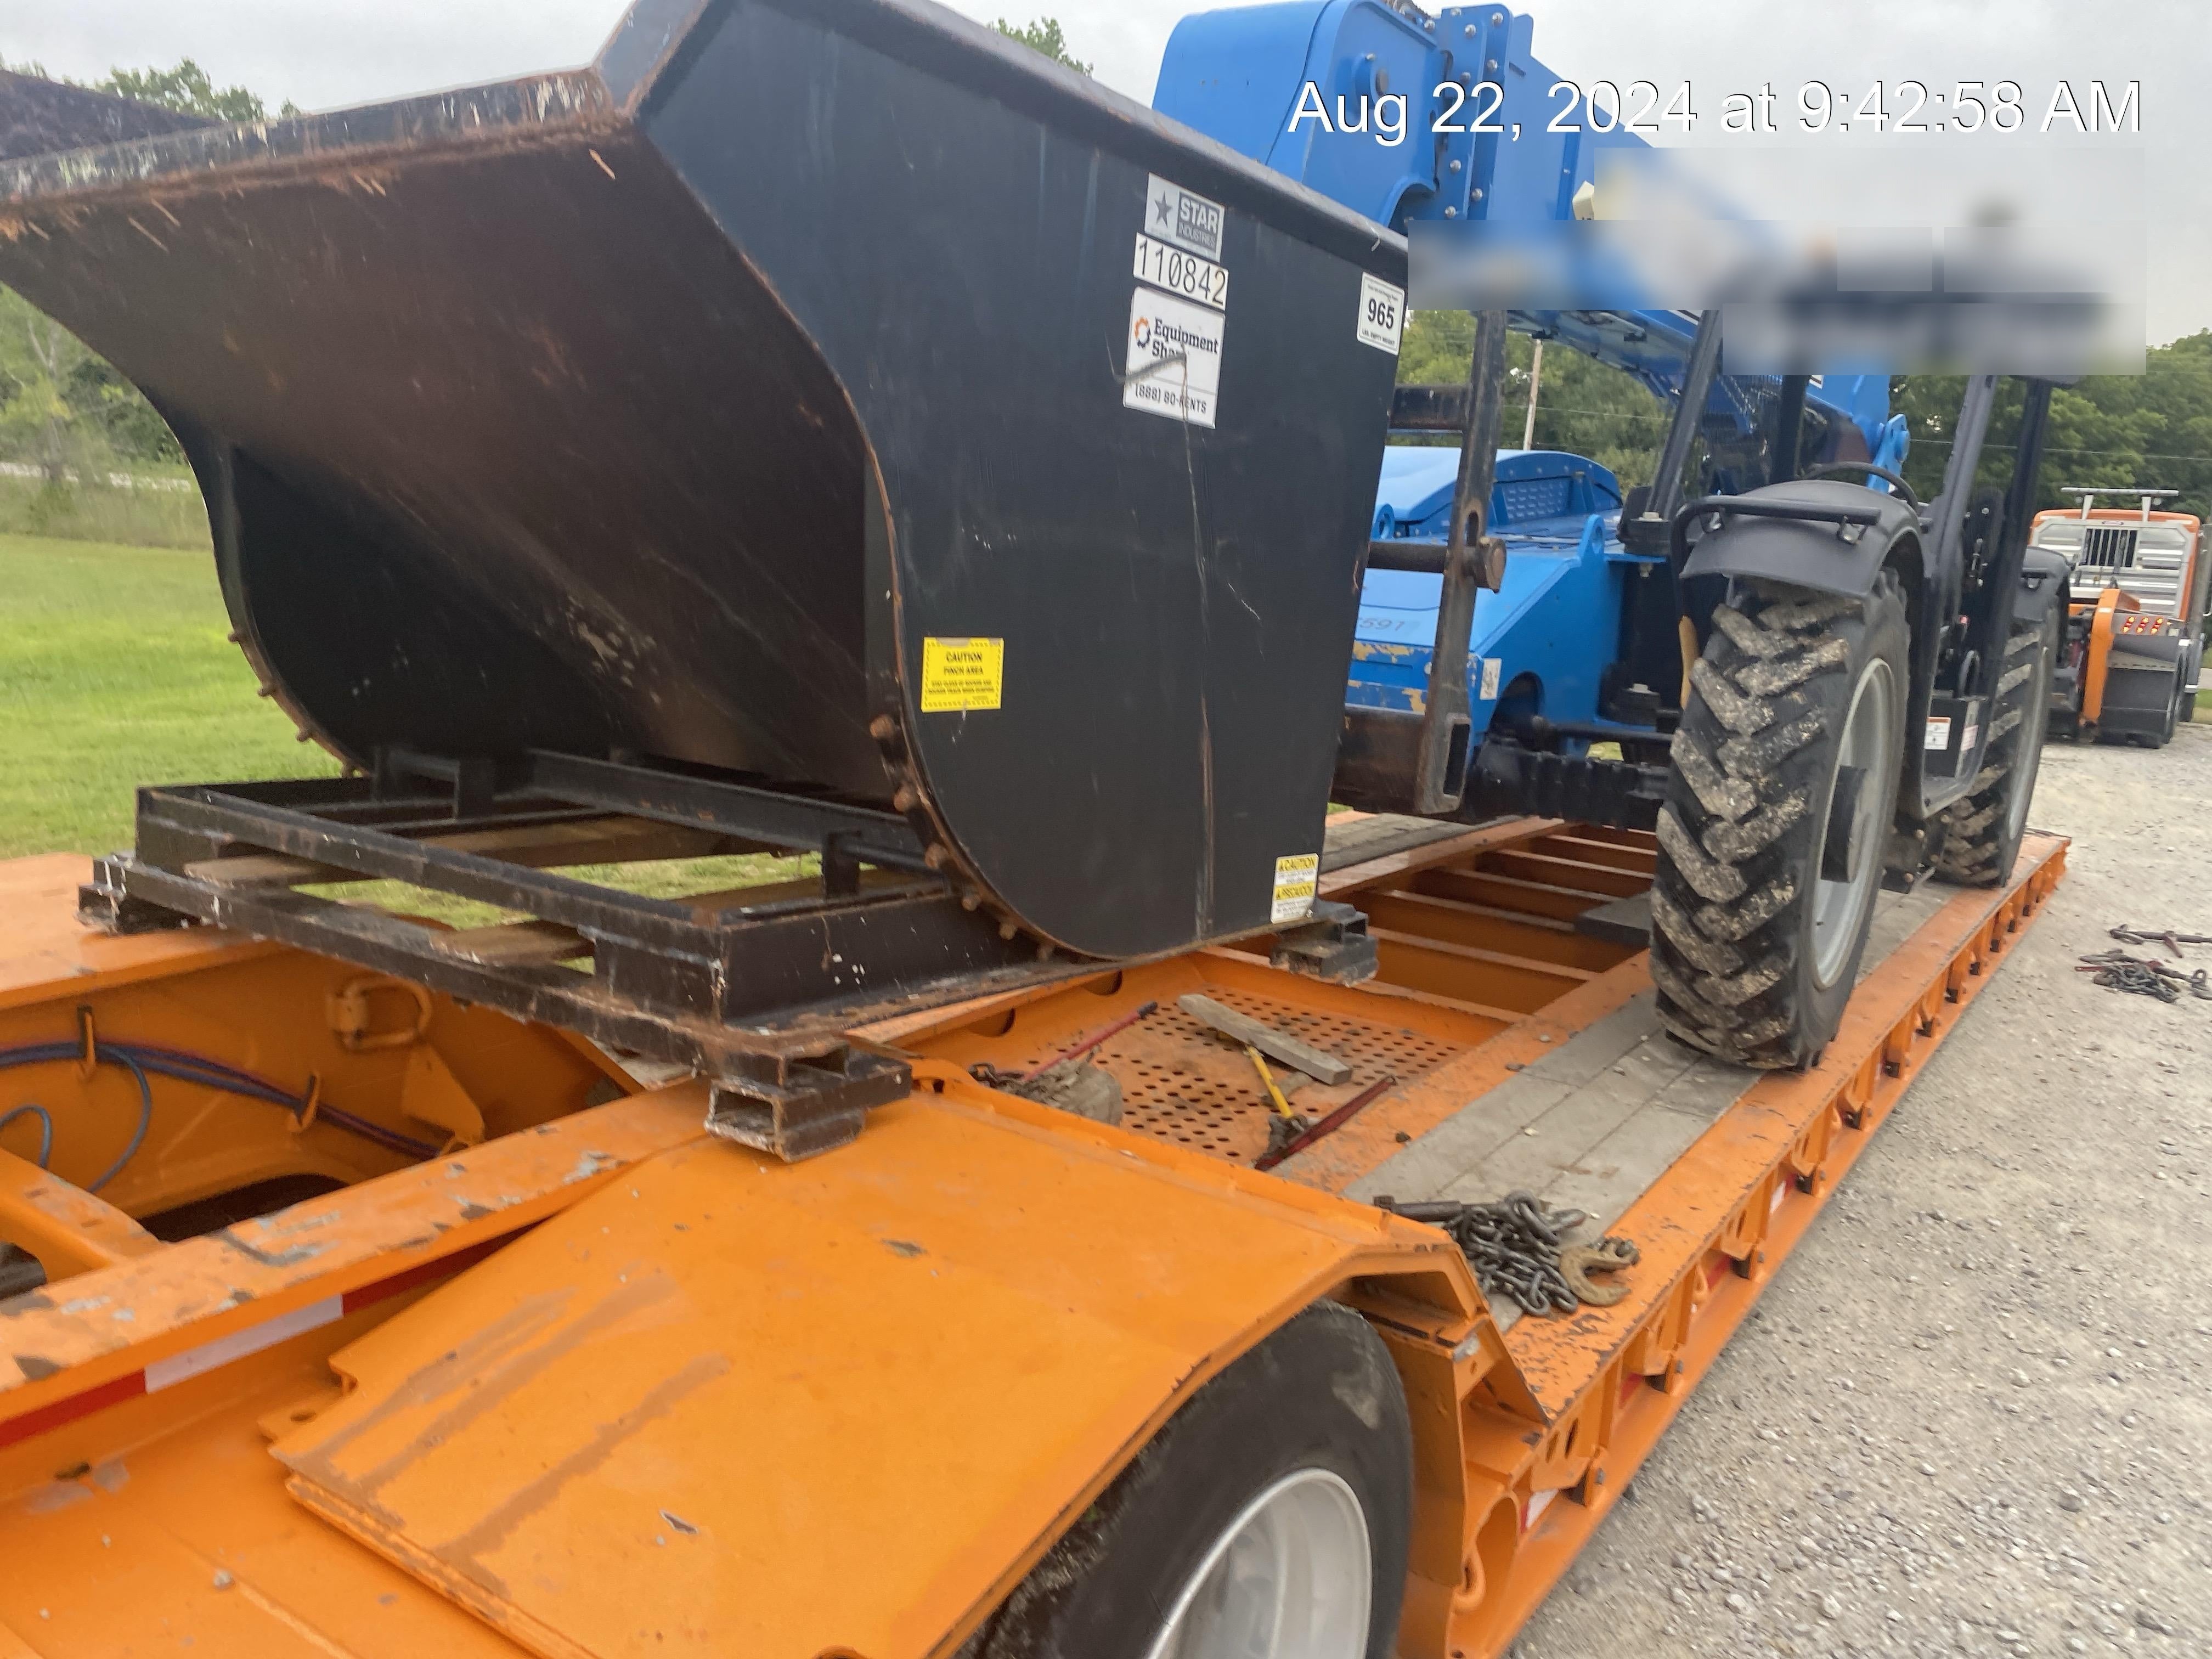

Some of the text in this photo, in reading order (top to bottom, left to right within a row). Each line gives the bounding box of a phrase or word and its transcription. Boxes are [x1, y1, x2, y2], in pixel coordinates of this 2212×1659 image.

[1180, 197, 1218, 233] STAR
[1138, 238, 1226, 306] 110842
[1368, 298, 1395, 329] 965
[1154, 316, 1219, 356] Equipment
[1135, 384, 1161, 403] (888)
[946, 651, 983, 663] CAUTION
